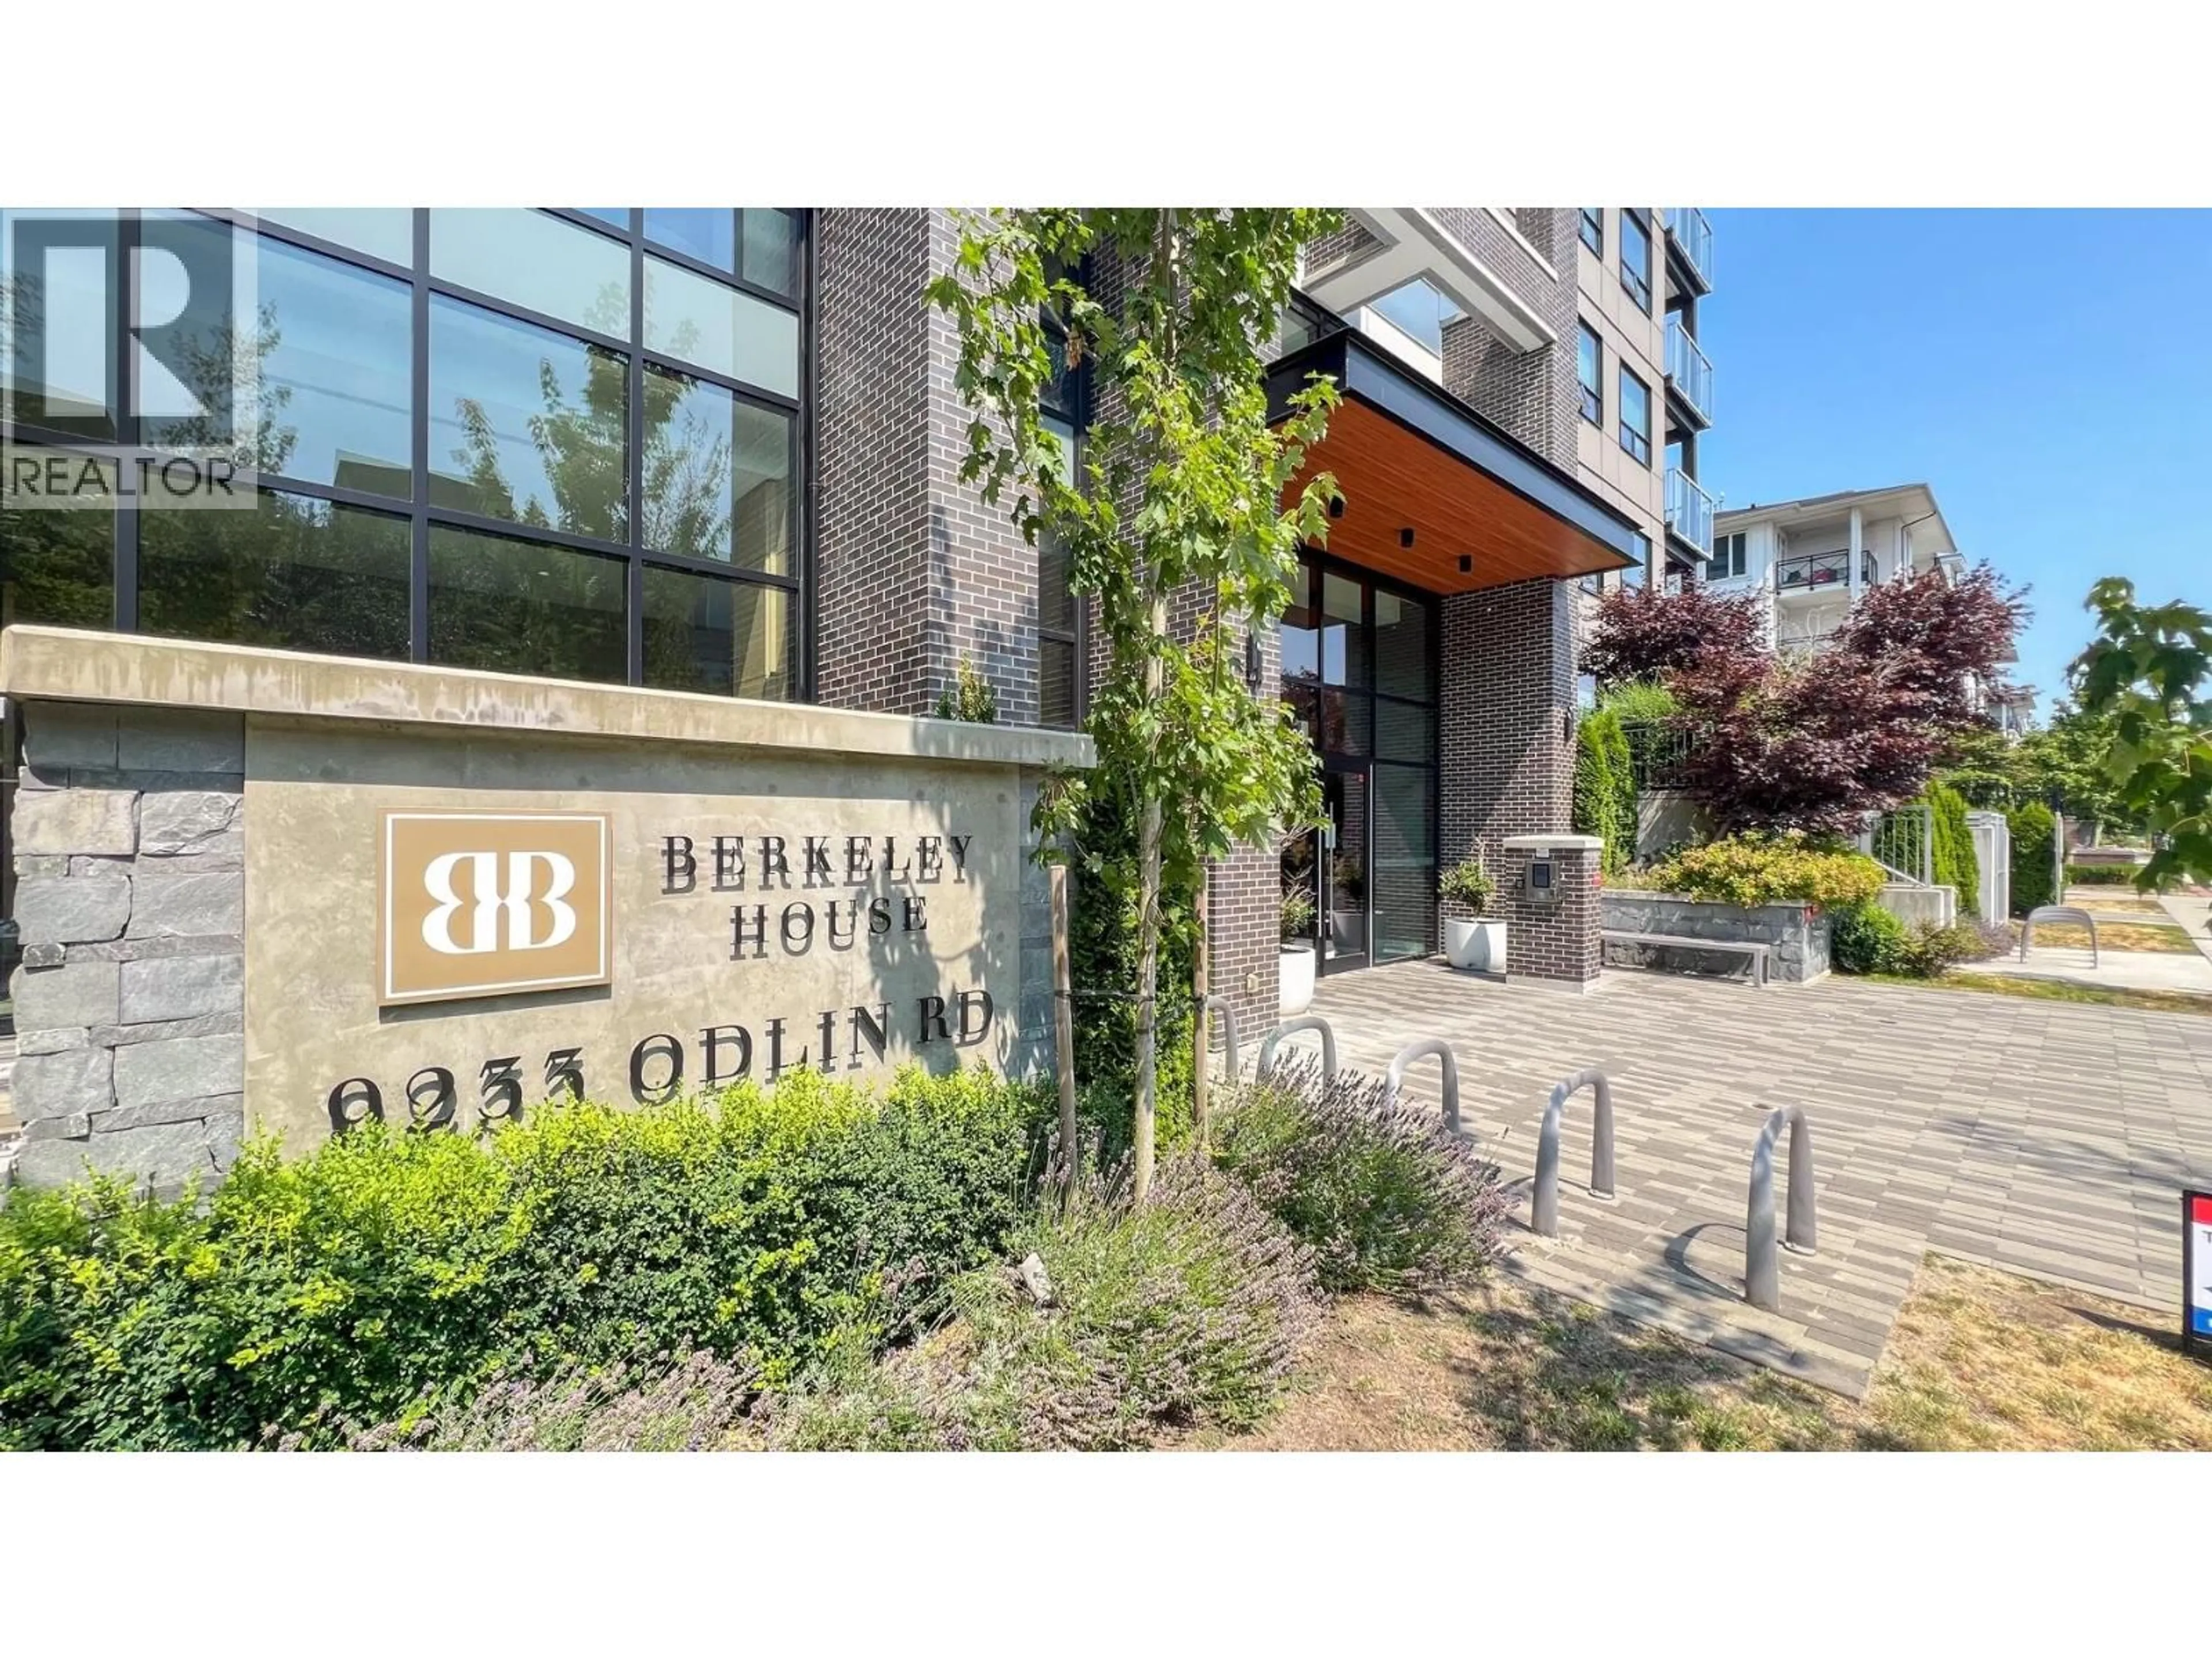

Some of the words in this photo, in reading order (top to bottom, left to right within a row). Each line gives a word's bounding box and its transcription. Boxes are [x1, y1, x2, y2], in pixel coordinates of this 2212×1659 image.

[661, 836, 974, 877] BERKELEY
[730, 896, 927, 945] HOUSE
[630, 999, 892, 1092] ODLIN
[916, 989, 994, 1044] RD
